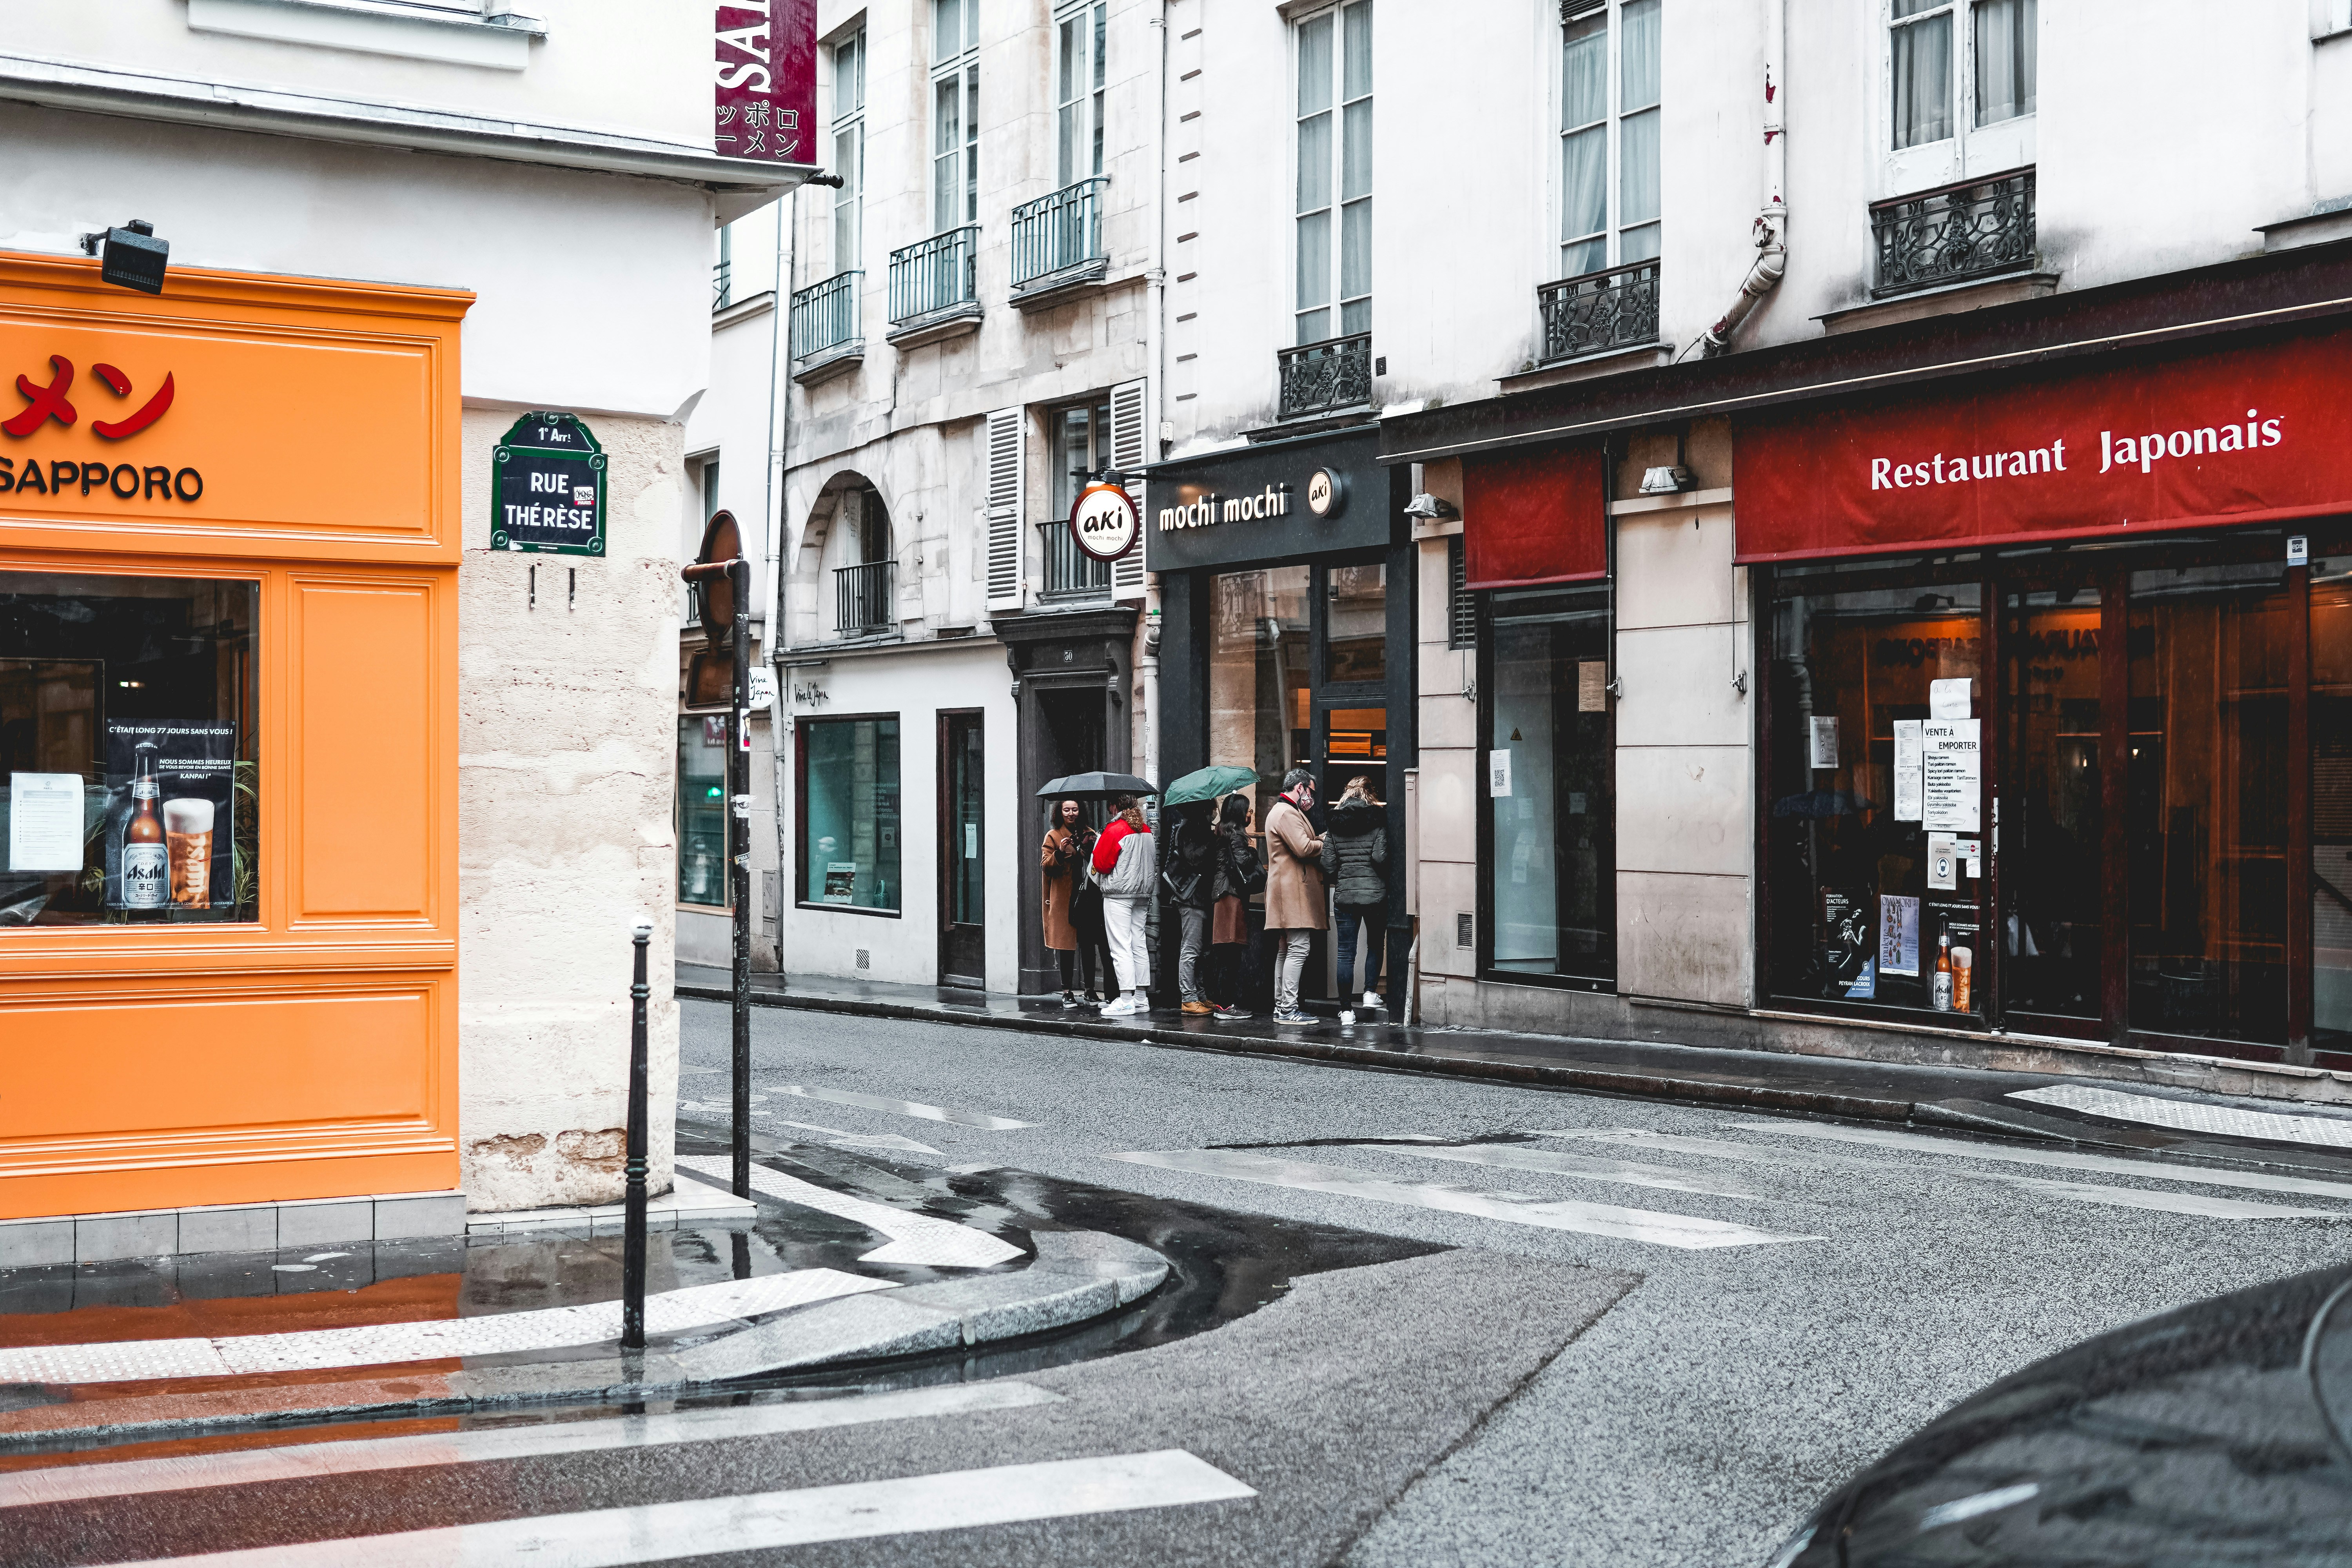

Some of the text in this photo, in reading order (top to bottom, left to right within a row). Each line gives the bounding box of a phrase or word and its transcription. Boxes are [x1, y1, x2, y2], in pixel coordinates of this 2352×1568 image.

[1, 354, 175, 439] メン
[1872, 408, 2282, 490] Restaurant Japonais
[0, 456, 203, 501] SAPPORO
[531, 472, 568, 494] RUE
[505, 502, 592, 530] THÉRÈSE
[1160, 482, 1285, 531] mochi mochi
[109, 725, 134, 734] C'ÉTAIT
[1925, 725, 1954, 736] VENTE À
[127, 863, 165, 880] Asahi
[1936, 984, 1952, 995] Asahi
